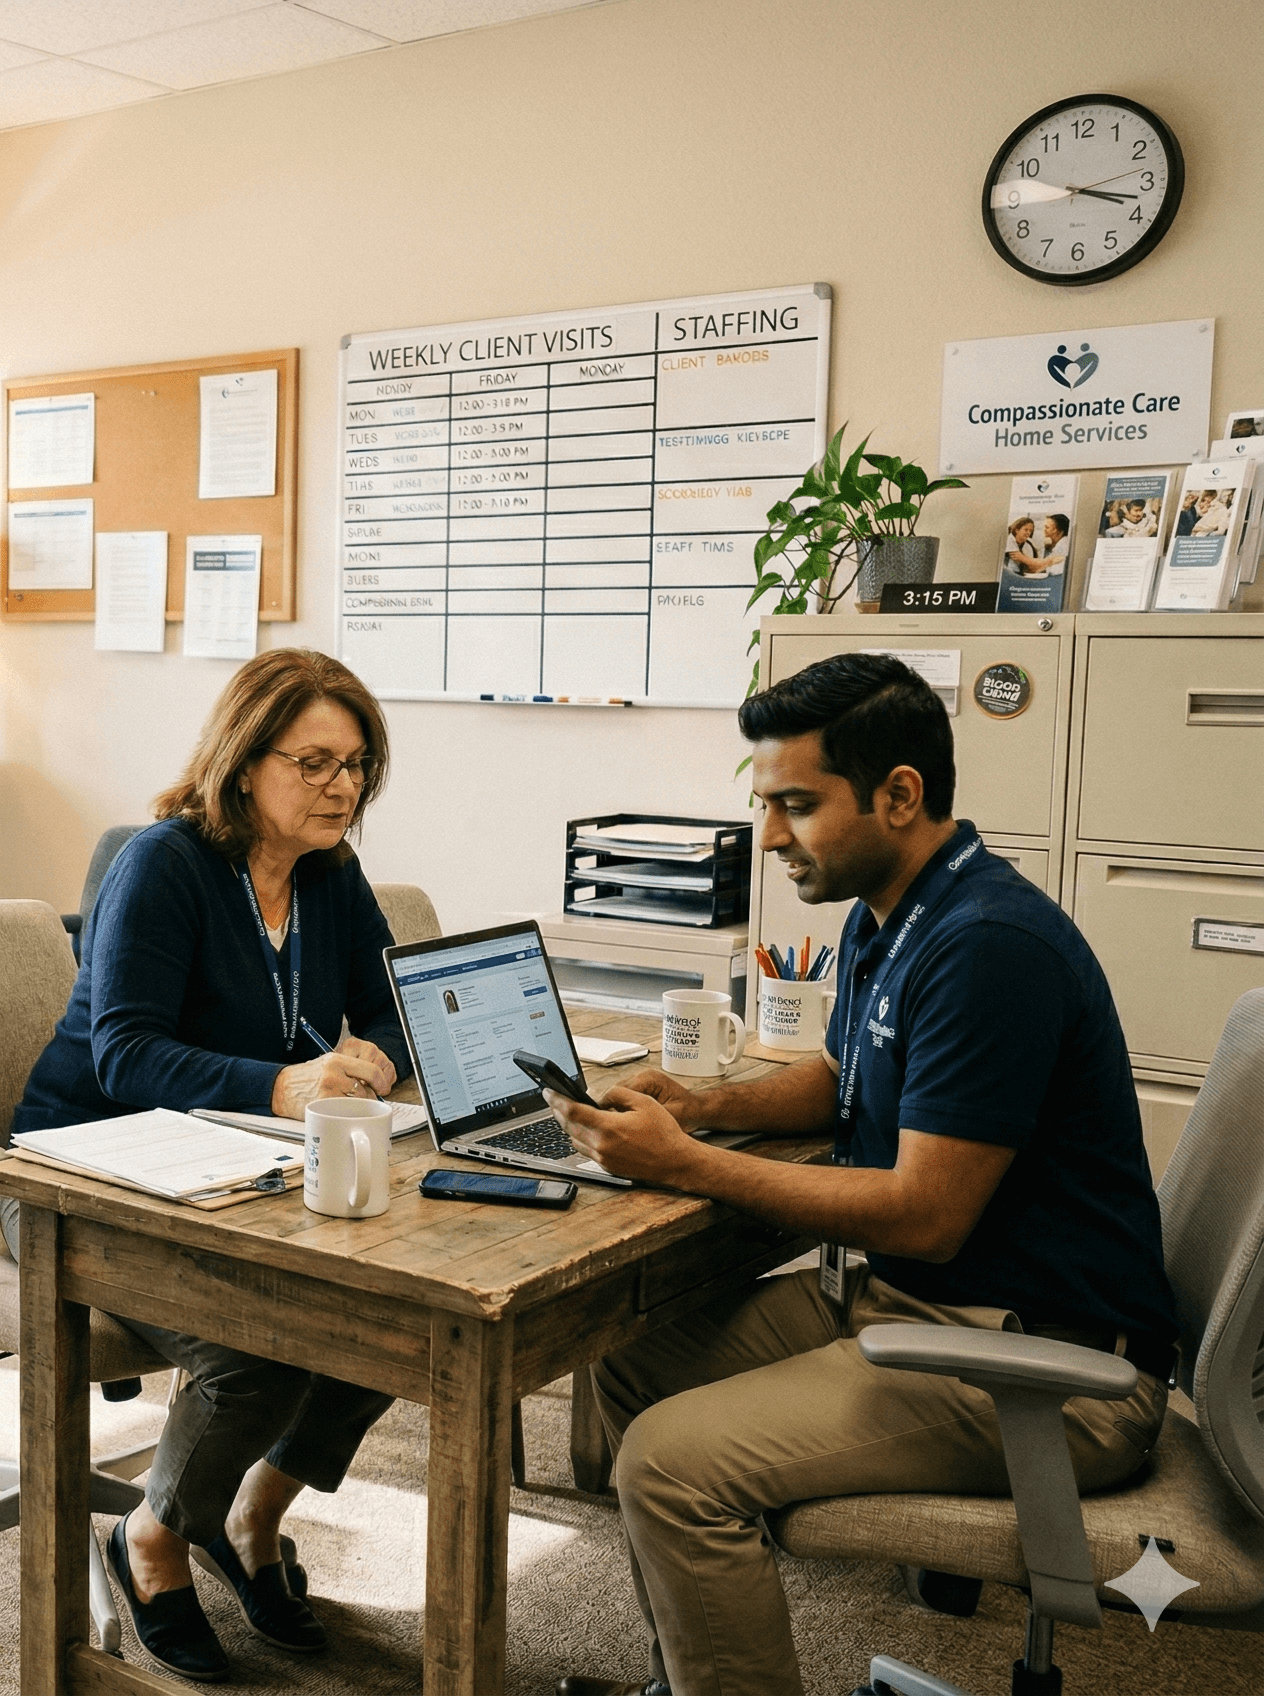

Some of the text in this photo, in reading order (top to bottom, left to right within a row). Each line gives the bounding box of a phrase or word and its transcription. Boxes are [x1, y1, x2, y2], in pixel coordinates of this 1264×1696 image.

[1071, 118, 1095, 139] 12
[1110, 122, 1120, 142] 1
[1040, 133, 1060, 153] 11
[1132, 140, 1147, 160] 2
[1016, 158, 1040, 178] 10
[1140, 171, 1155, 191] 3
[1007, 190, 1021, 209] 9
[1129, 205, 1143, 224] 4
[1016, 220, 1030, 239] 8
[1040, 238, 1054, 257] 7
[1103, 230, 1118, 250] 5
[1071, 242, 1085, 261] 6
[673, 307, 798, 341] STAFFING
[369, 325, 613, 371] WEEKLY CLIENT VISITS
[662, 356, 706, 371] CLIENT
[479, 373, 518, 386] FRIDAY
[349, 410, 375, 421] MON
[968, 393, 1181, 426] Compassionate Care
[349, 433, 378, 444] TUES
[995, 421, 1148, 448] Home Services
[349, 456, 379, 468] WEDS
[348, 504, 365, 514] FRI
[903, 590, 976, 606] 3:15 PM
